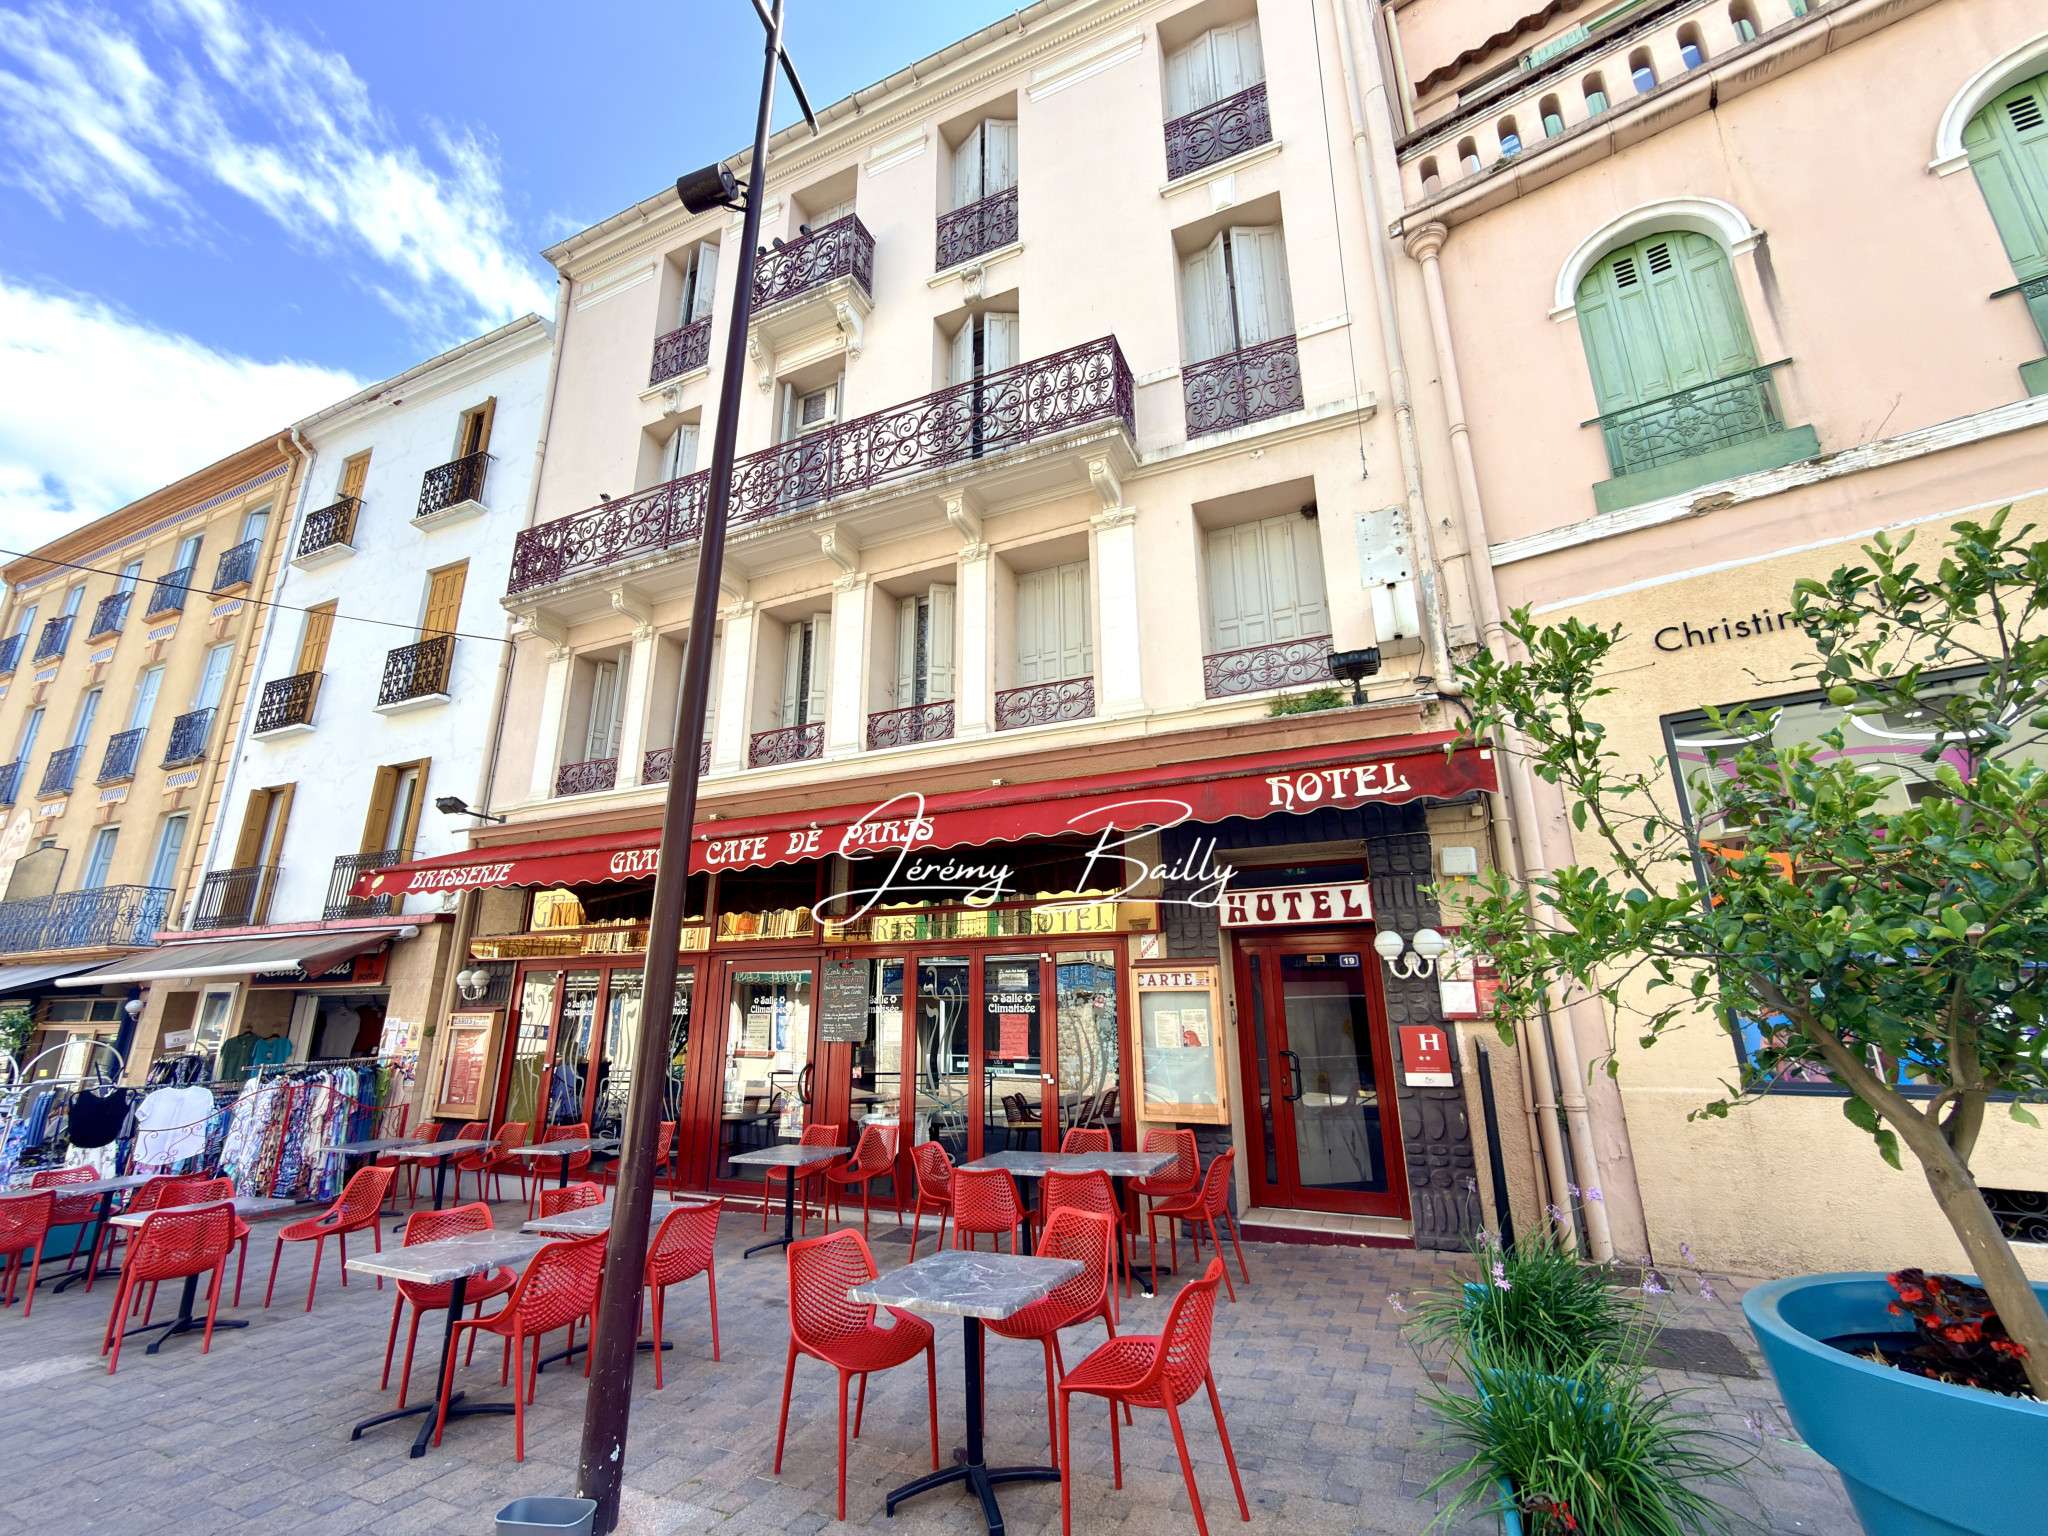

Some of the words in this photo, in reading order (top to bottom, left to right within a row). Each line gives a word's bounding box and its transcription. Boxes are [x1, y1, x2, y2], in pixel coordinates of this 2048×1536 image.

[1265, 762, 1412, 810] HOTEL
[610, 848, 661, 874] GRA
[1227, 889, 1364, 924] HOTEL
[1343, 957, 1355, 965] 19
[1137, 973, 1193, 987] CARTE
[1000, 993, 1023, 1003] Salle
[988, 1003, 1036, 1014] Climatisée
[1416, 1033, 1440, 1051] H
